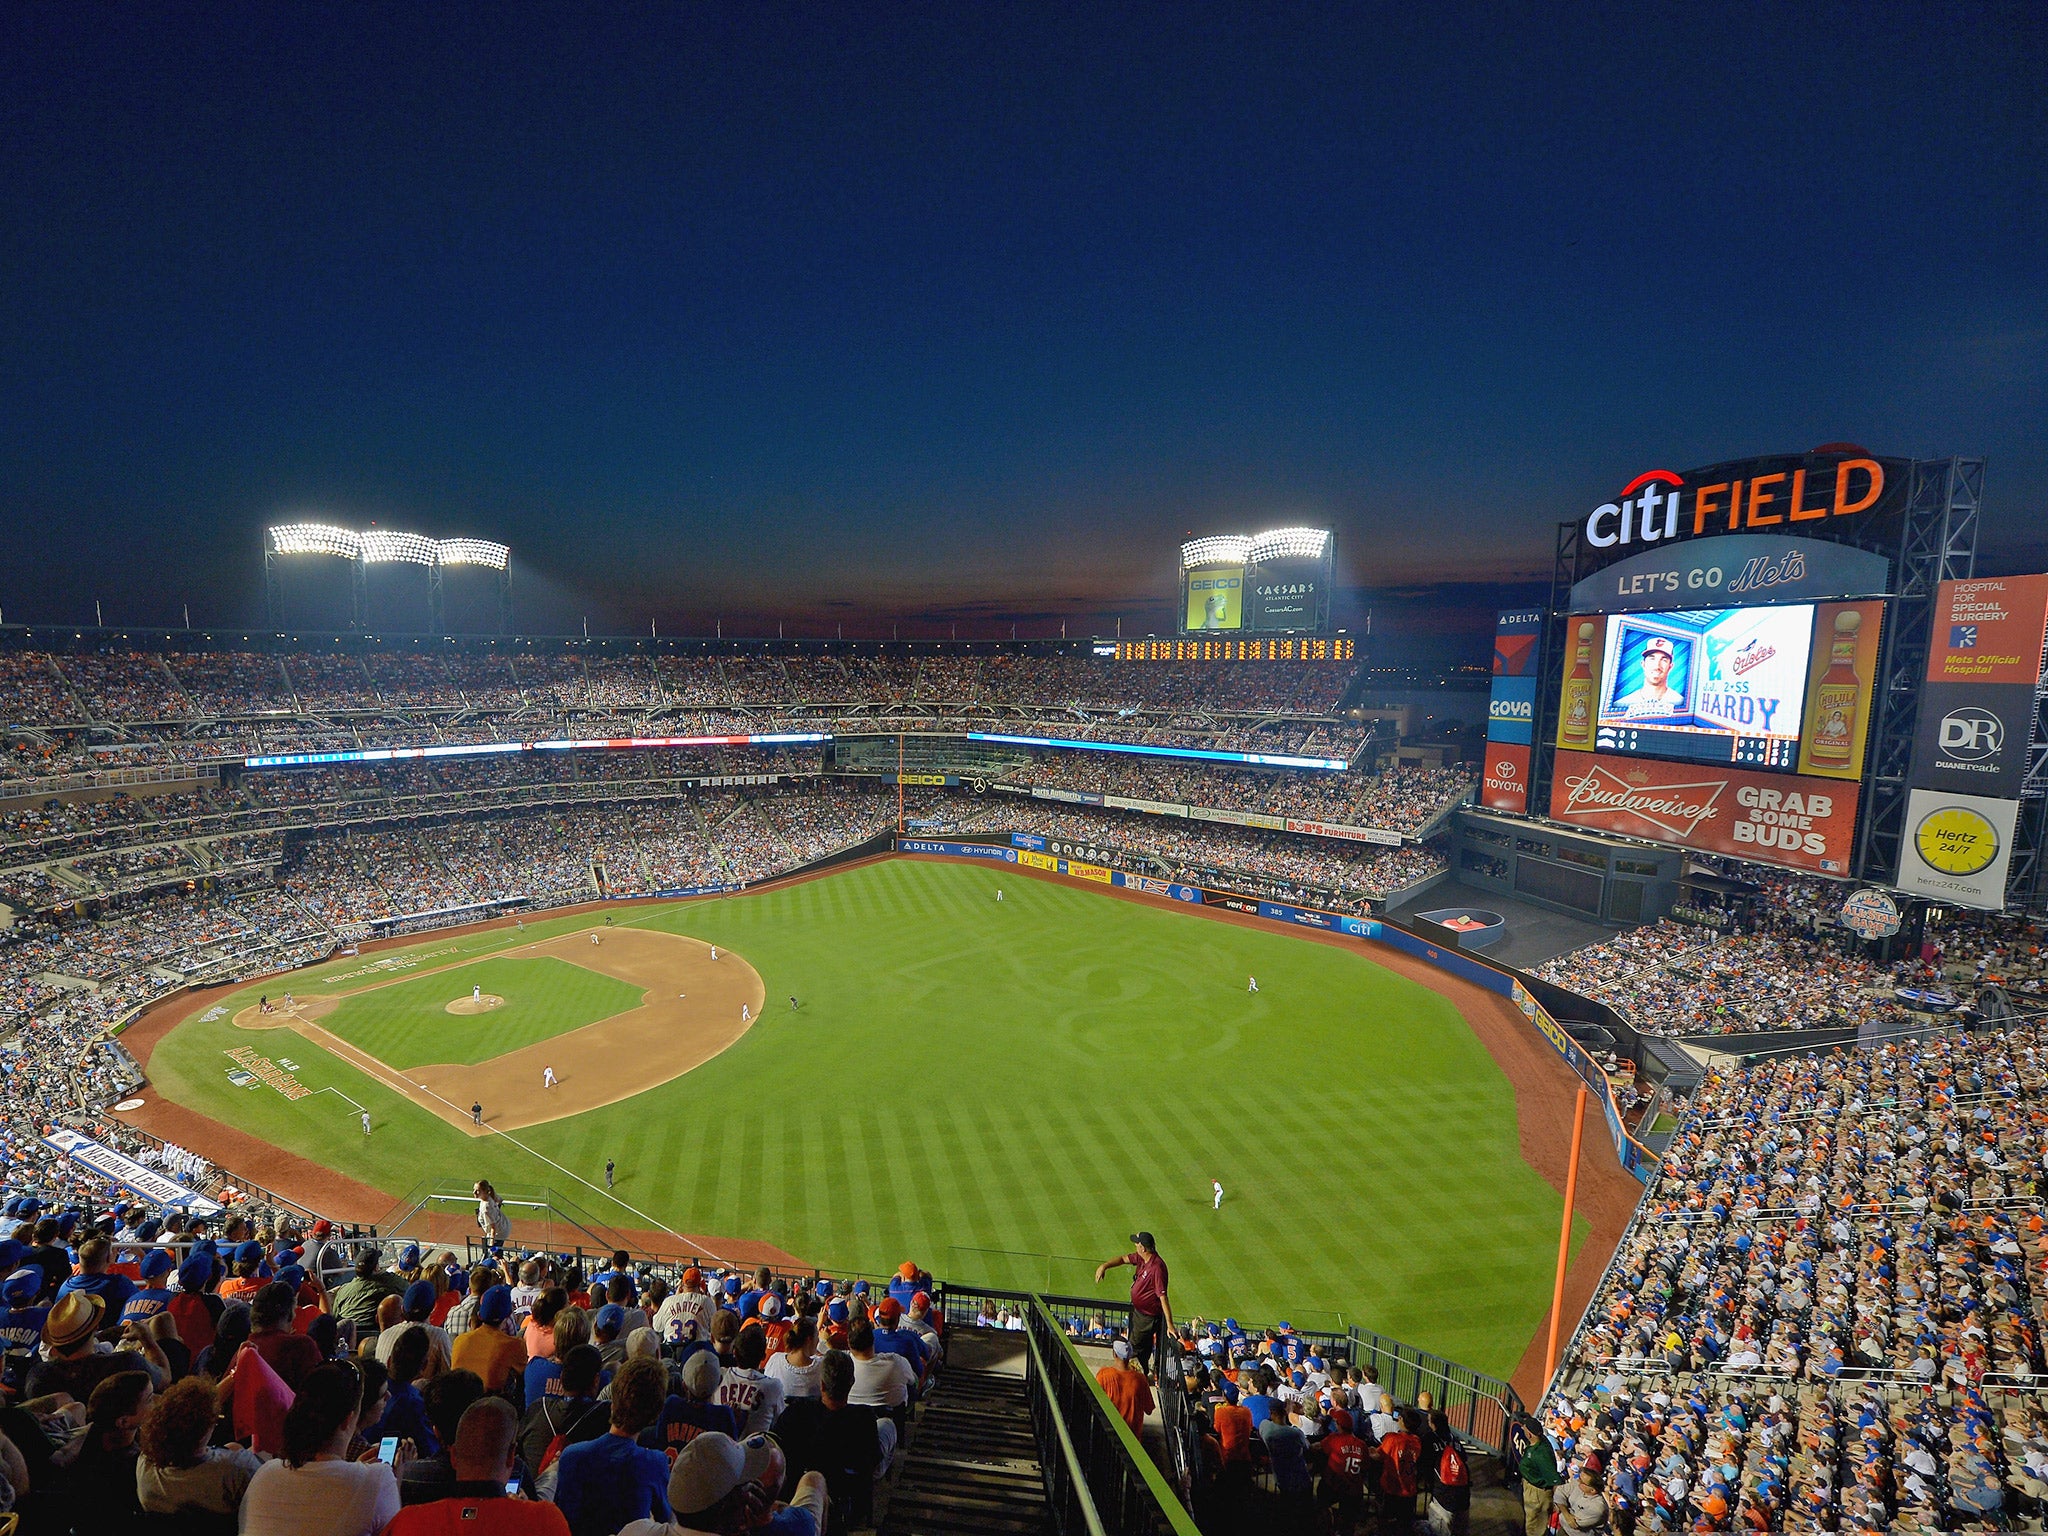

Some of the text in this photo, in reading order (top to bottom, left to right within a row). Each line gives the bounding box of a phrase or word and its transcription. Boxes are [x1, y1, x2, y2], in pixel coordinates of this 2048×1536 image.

[1586, 459, 1884, 547] citi FIELD
[1618, 551, 1806, 596] LET'S GO Mets
[1191, 578, 1240, 590] GEICO
[1256, 583, 1314, 595] CAESARS
[1954, 582, 2006, 593] HOSPITAL
[1953, 593, 1976, 602] FOR
[1952, 602, 2001, 612] SPECIAL
[1509, 614, 1540, 623] DELTA
[1950, 612, 2009, 622] SURGERY
[1945, 655, 2021, 664] Mets Official
[1944, 665, 1992, 675] Hospital
[1490, 701, 1532, 717] GOYA
[1701, 692, 1780, 731] HARDY
[1815, 738, 1849, 746] ORIGINAL
[1939, 718, 1999, 752] DR
[897, 774, 945, 785] GEICO
[1486, 778, 1525, 793] TOYOTA
[1051, 788, 1081, 801] Authority
[1564, 775, 1718, 820] Budweiser
[1736, 785, 1833, 818] GRAB
[1110, 798, 1181, 812] Alliance Building Services
[1287, 820, 1323, 834] BOB'S
[1750, 809, 1813, 831] SOME
[1324, 829, 1366, 840] FURNITURE
[1733, 820, 1827, 855] BUDS
[1935, 829, 1978, 844] Hertz
[914, 843, 945, 852] DELTA
[974, 847, 1003, 856] HYUNDAI
[1939, 842, 1970, 855] 24/7
[1917, 877, 1982, 896] hertz247.com
[1226, 900, 1257, 913] verizon
[1270, 908, 1282, 916] 385
[1349, 922, 1371, 936] citi
[1851, 916, 1885, 932] GAME
[1535, 1009, 1567, 1054] GEICO
[276, 1058, 300, 1071] MLB
[82, 1147, 179, 1200] NATIONAL LEAGUE
[124, 1299, 164, 1316] HARVEY
[670, 1301, 704, 1316] HARVEY
[670, 1319, 698, 1343] 33
[1287, 1346, 1297, 1360] 5
[720, 1383, 765, 1411] REYES
[1344, 1456, 1362, 1475] 15
